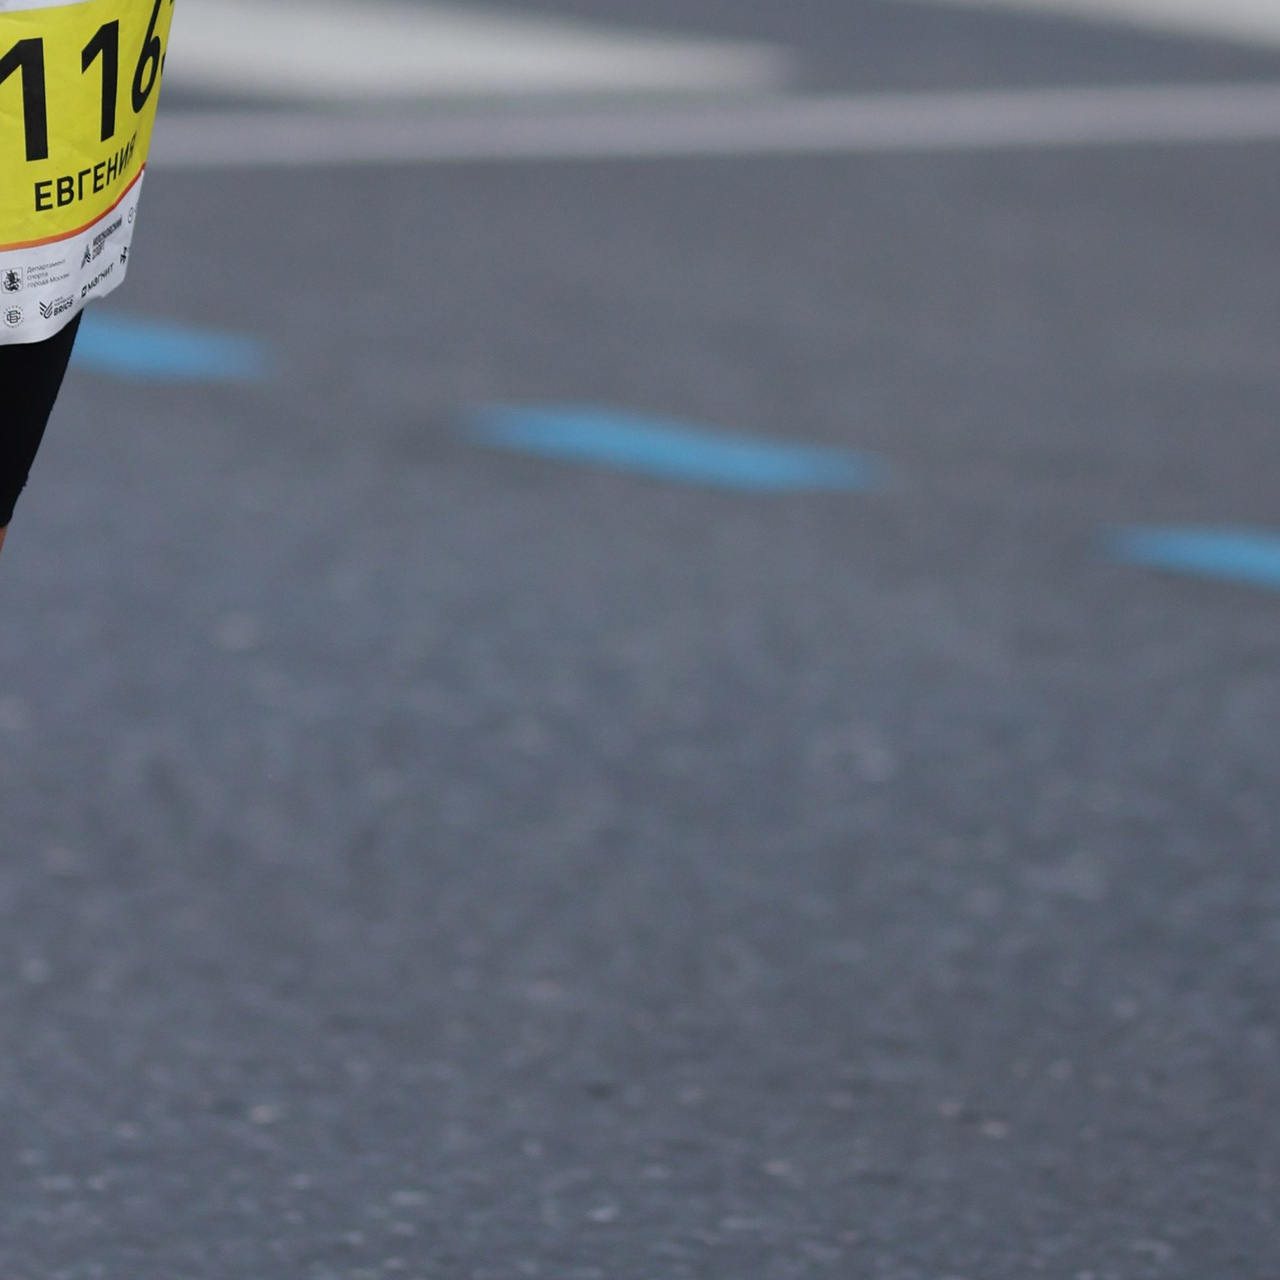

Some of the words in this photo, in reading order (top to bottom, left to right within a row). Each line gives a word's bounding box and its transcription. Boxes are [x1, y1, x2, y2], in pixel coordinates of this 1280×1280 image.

[26, 271, 49, 282] спорта
[27, 278, 49, 289] города
[53, 299, 74, 317] BRICS
